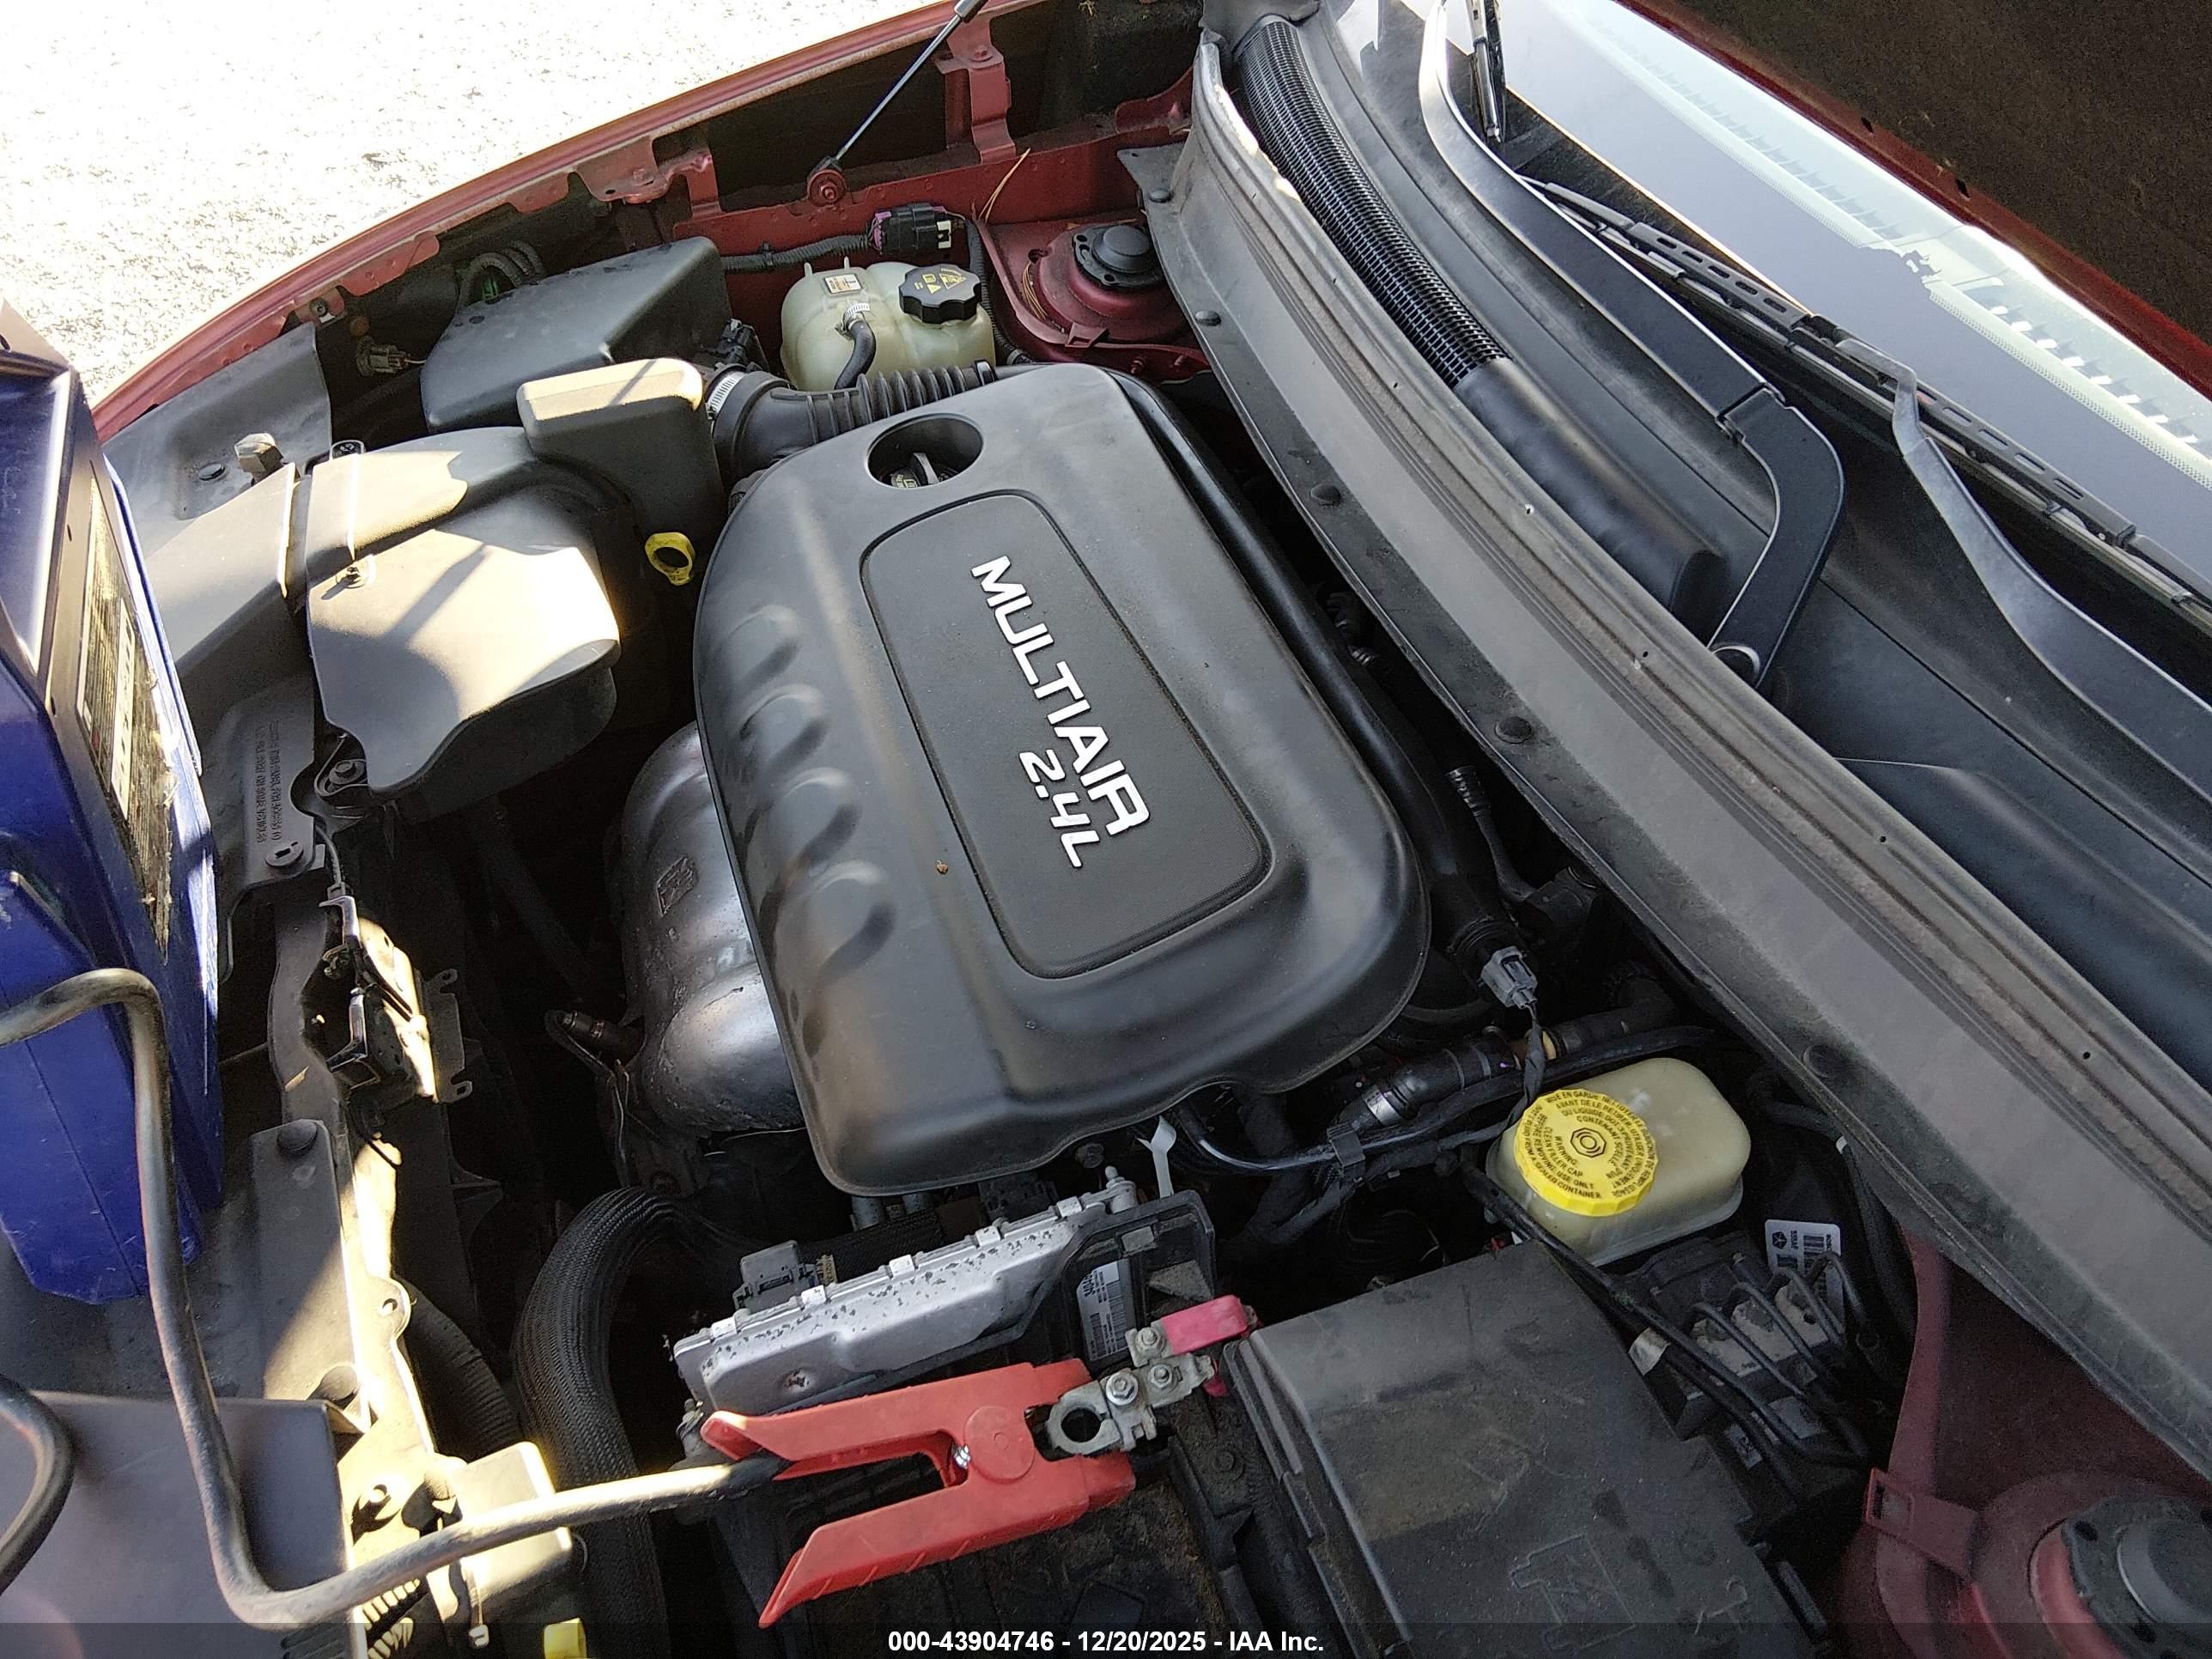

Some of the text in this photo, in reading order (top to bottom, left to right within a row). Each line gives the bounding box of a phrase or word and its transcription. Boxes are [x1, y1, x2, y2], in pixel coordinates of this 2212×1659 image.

[970, 556, 1151, 836] MULTIAIR
[1018, 749, 1100, 868] 2.4L
[1556, 1099, 1578, 1109] AVANT
[1576, 1115, 1621, 1139] CONTENANT
[1604, 1115, 1620, 1126] DOT
[1556, 1170, 1572, 1182] USE
[1572, 1179, 1594, 1188] ONLY
[1566, 1166, 1583, 1177] CAP
[1556, 1181, 1601, 1198] CONTAINER
